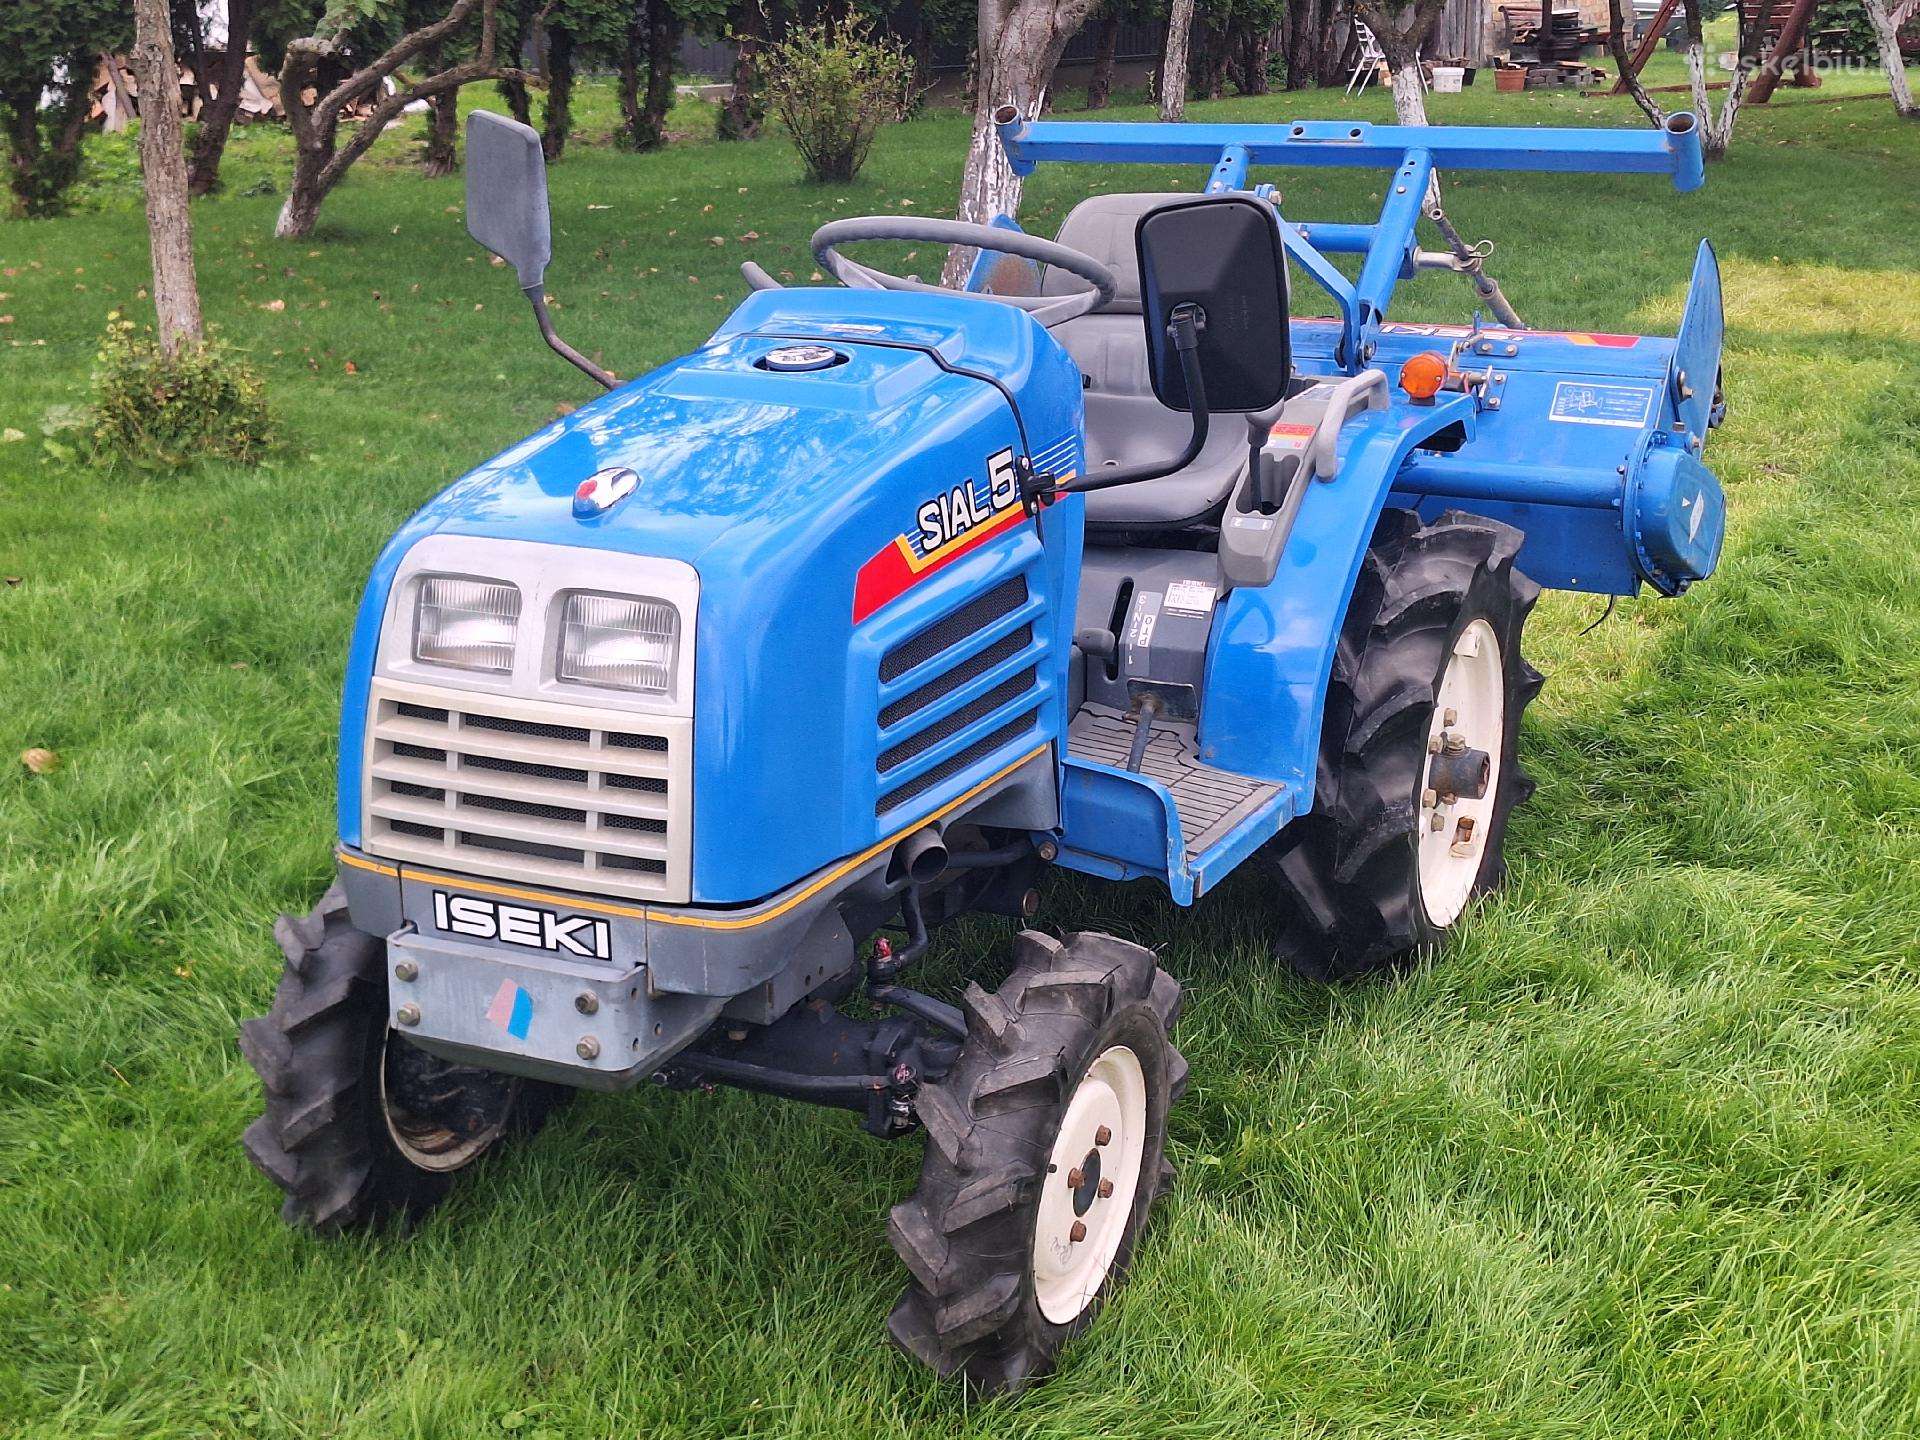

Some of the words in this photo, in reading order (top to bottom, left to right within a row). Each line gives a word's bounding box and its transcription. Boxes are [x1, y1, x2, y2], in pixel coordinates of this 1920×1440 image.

[917, 478, 990, 552] SIAL
[986, 445, 1018, 510] 5
[433, 890, 612, 961] ISEKI
